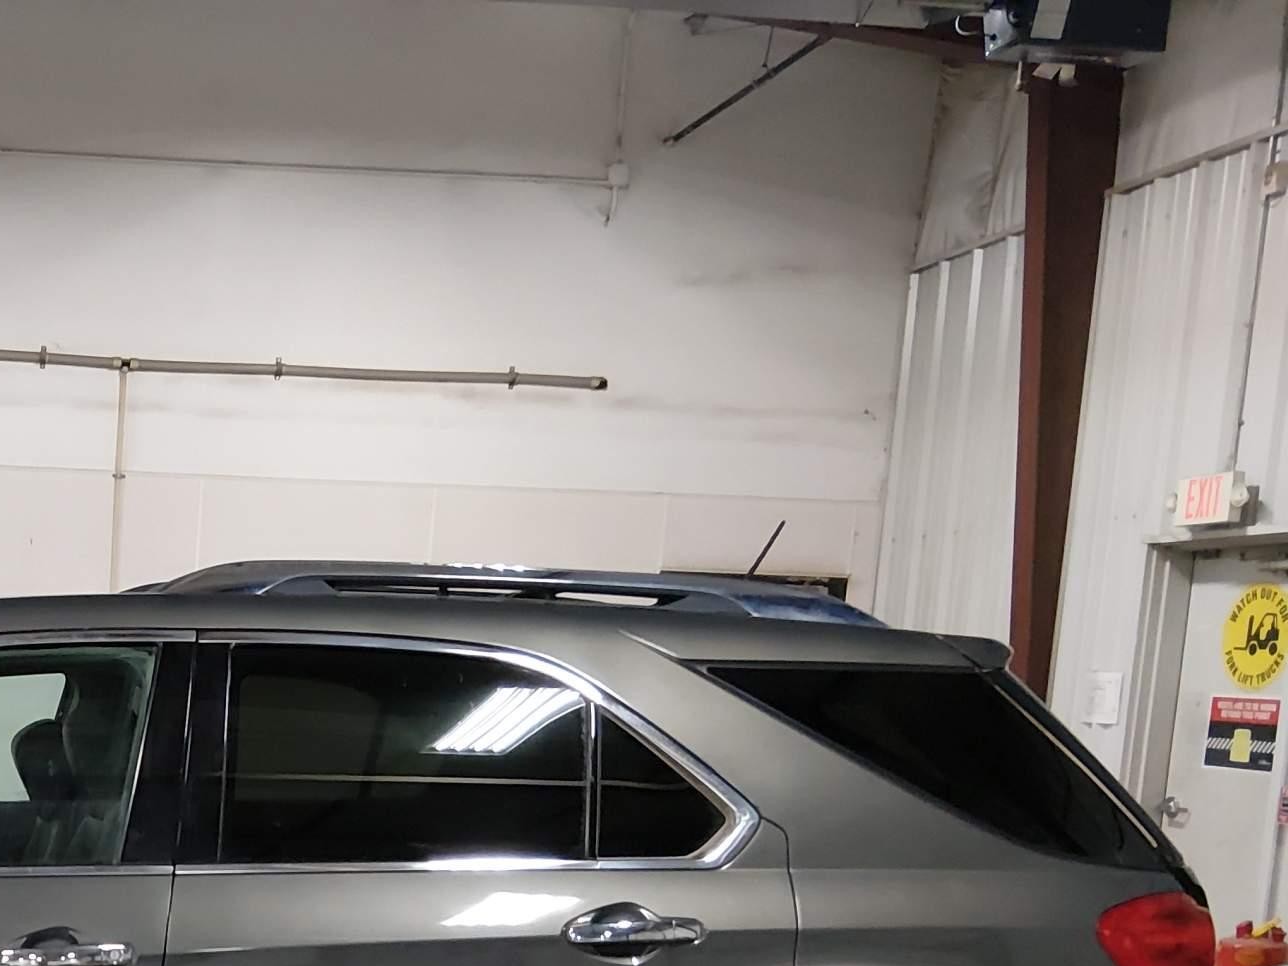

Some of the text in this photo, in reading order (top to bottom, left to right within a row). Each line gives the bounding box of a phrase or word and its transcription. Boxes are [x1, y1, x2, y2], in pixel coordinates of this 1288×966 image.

[1185, 475, 1225, 520] EXIT
[1230, 588, 1258, 622] WATCH
[1260, 587, 1278, 602] OUT
[1225, 650, 1285, 686] FORK LIFT TRUCKS
